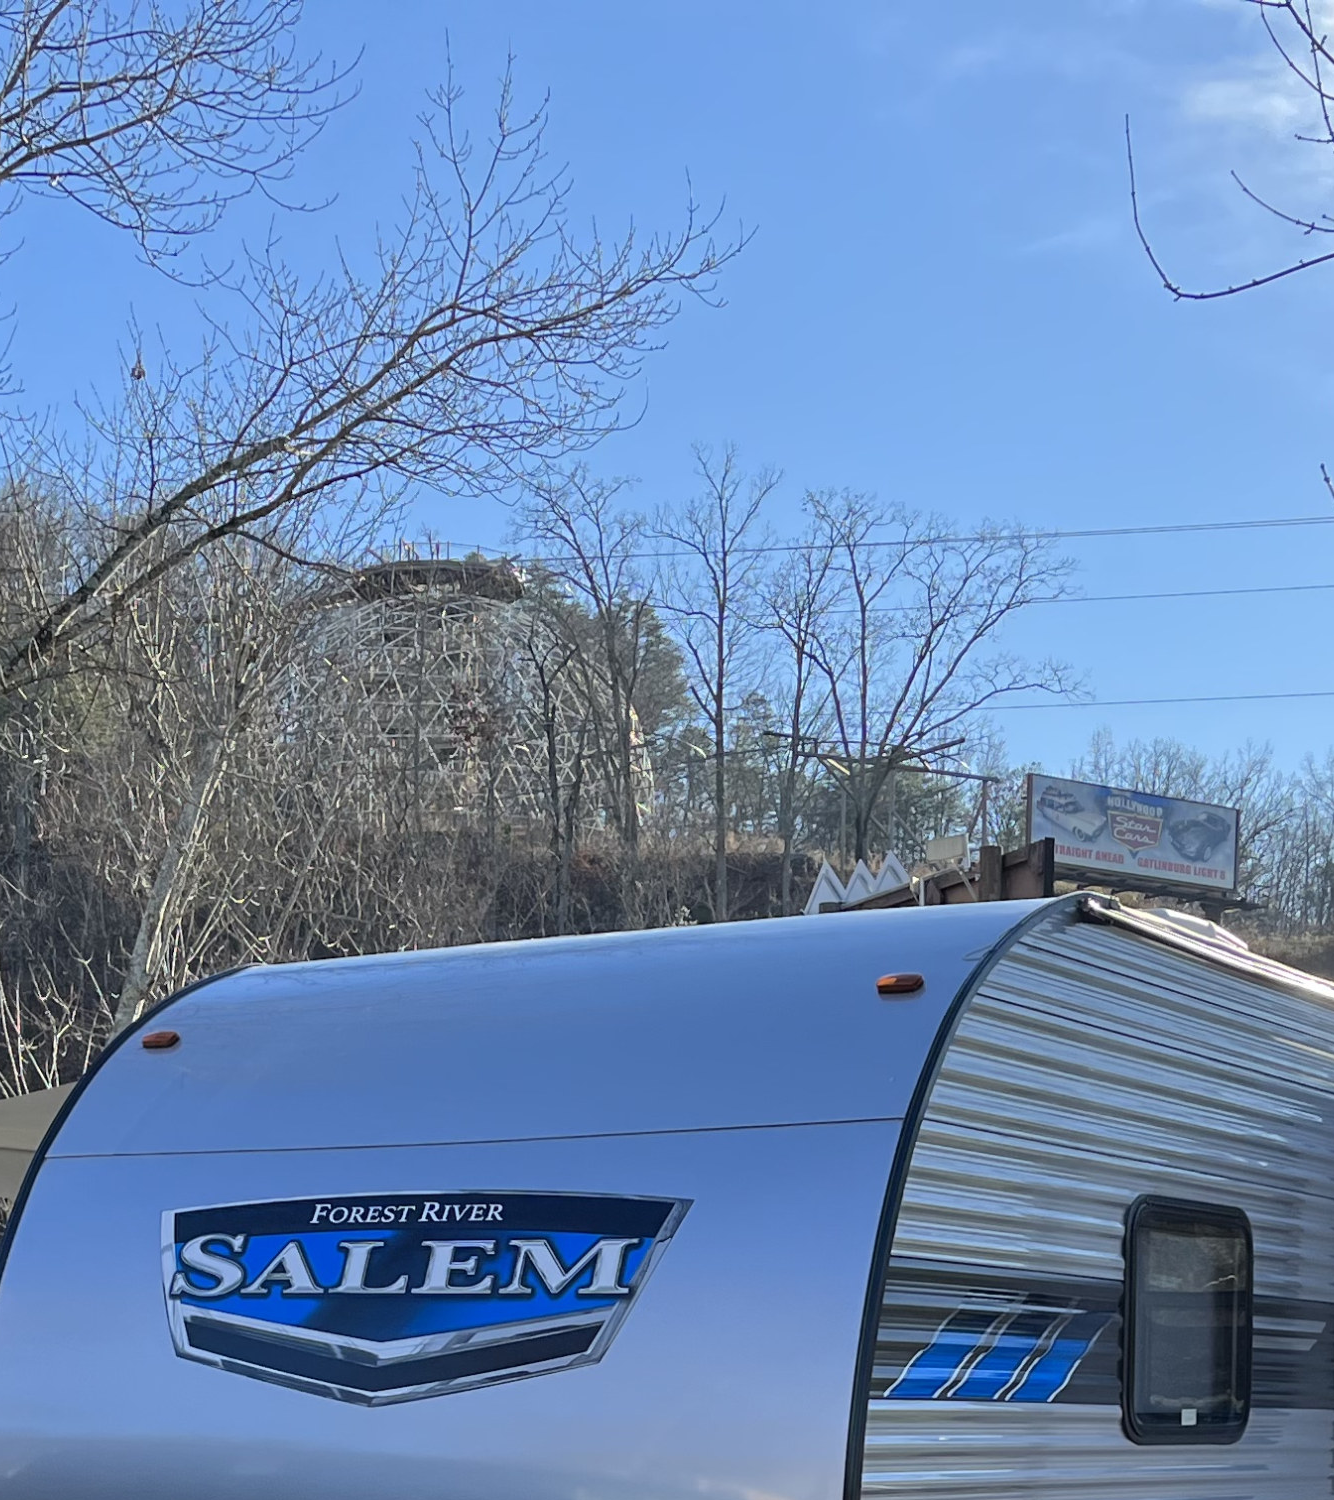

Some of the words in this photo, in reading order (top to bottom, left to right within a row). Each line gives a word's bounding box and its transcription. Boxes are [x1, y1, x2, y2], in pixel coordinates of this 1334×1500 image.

[1107, 795, 1163, 817] HOLLYWOOD
[1112, 815, 1157, 834] Star
[1113, 826, 1156, 844] Cars
[1054, 844, 1093, 859] TRAIGHT
[1137, 857, 1192, 875] GATLINBURG
[1193, 867, 1219, 880] LIGHT
[309, 1202, 415, 1225] FOREST
[417, 1200, 505, 1223] RIVER
[170, 1233, 640, 1298] SALEM
